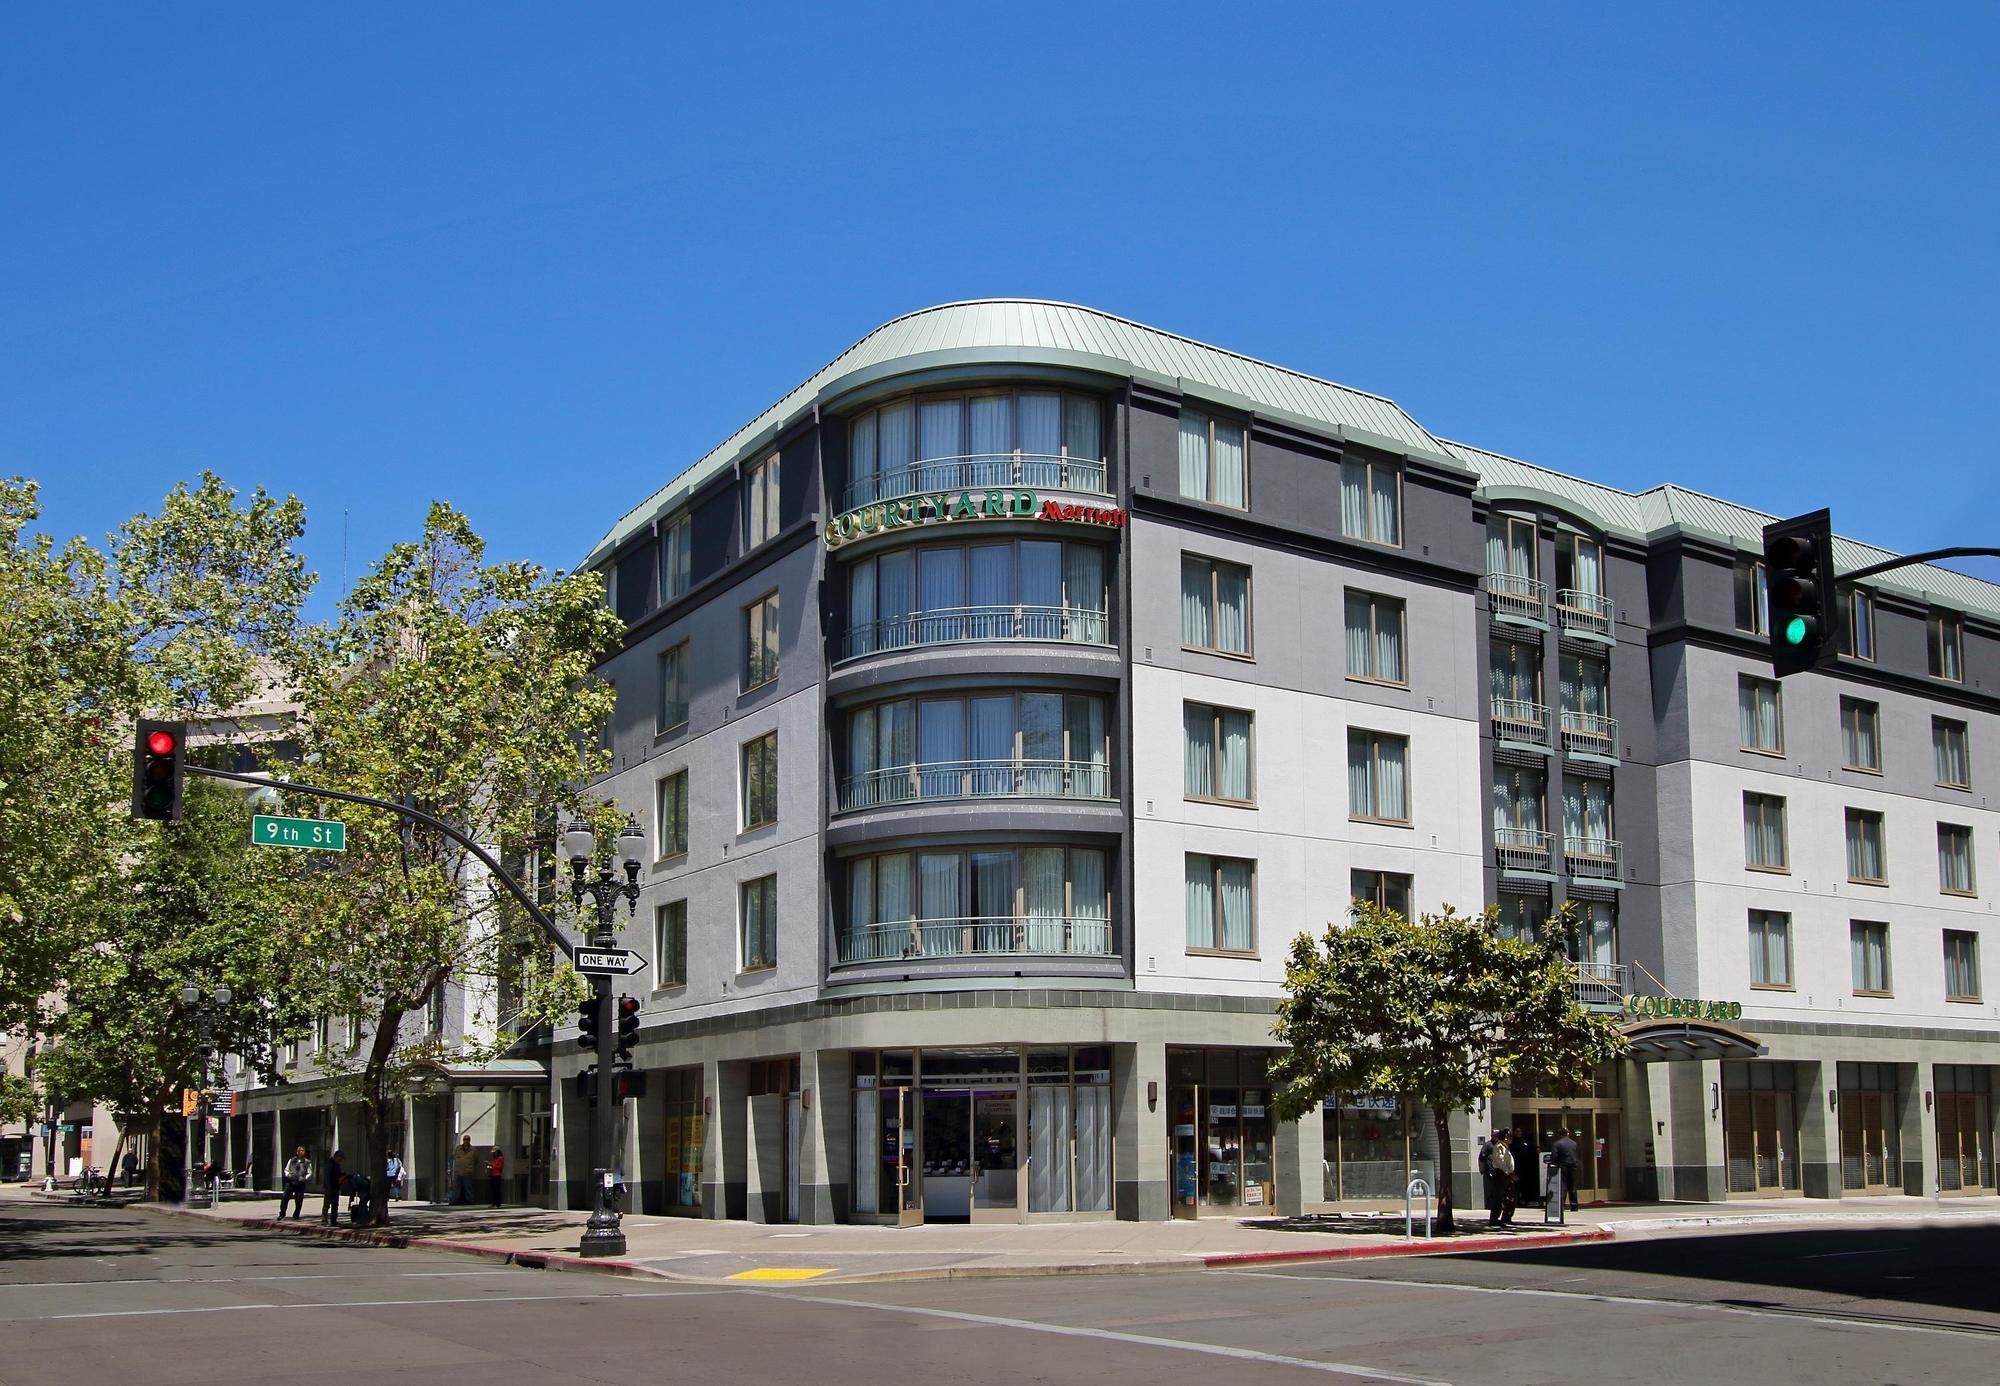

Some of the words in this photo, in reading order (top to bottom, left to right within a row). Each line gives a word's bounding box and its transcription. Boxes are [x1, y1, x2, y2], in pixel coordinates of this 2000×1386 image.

[823, 489, 1038, 545] COURTYARD
[1040, 500, 1127, 527] Marriott
[266, 822, 298, 841] 9th
[312, 826, 332, 844] St
[582, 955, 603, 966] ONE
[606, 956, 627, 967] WAY
[1629, 992, 1742, 1021] COURTYARD
